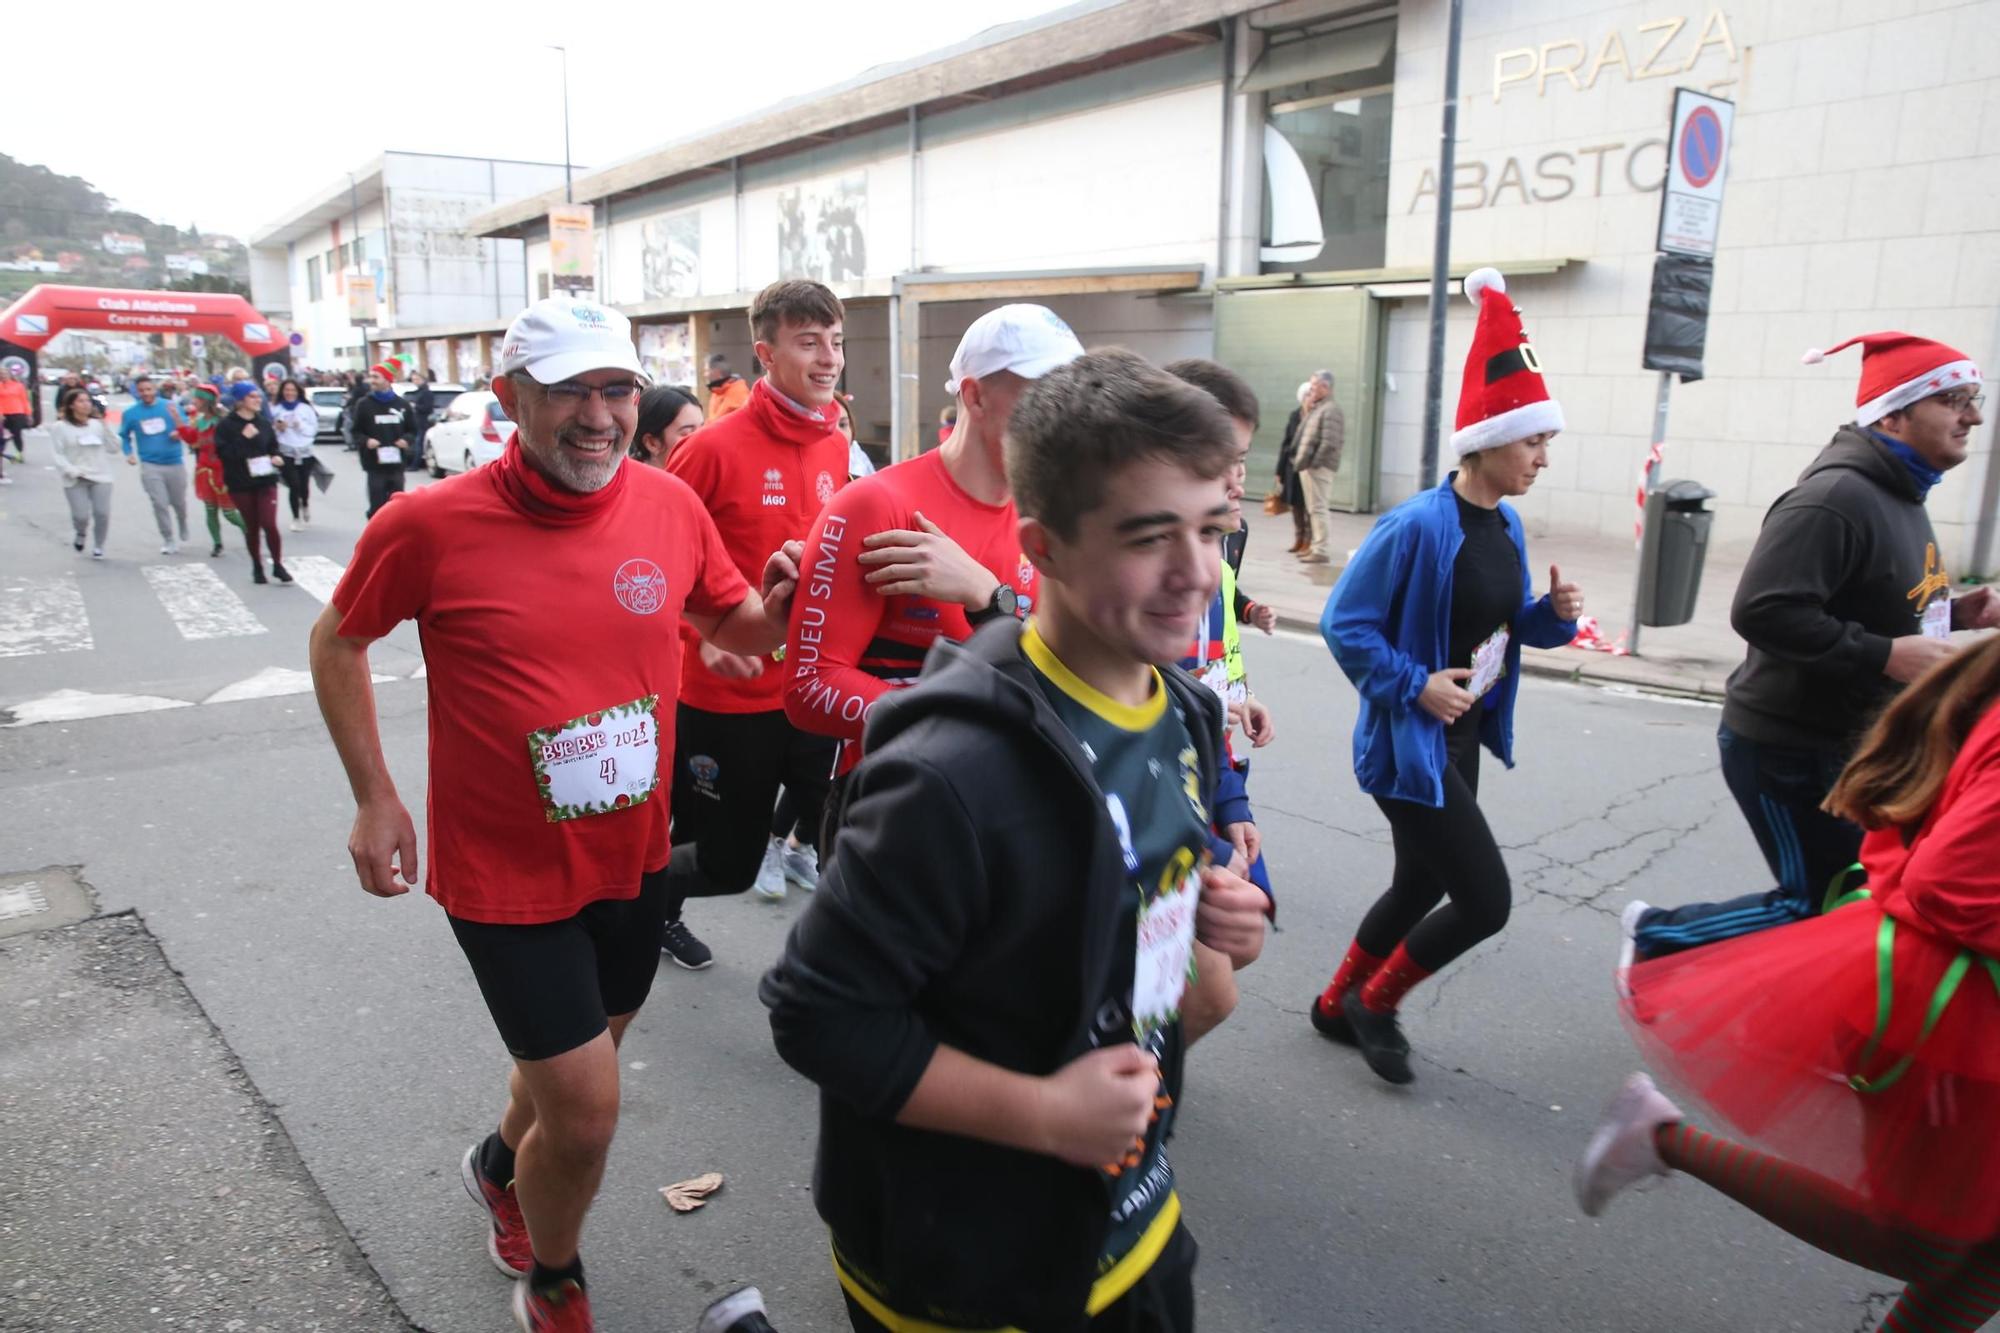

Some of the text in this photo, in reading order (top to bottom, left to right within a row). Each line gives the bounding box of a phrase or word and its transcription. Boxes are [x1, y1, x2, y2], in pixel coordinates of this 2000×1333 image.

[1493, 8, 1738, 104] PRAZA
[1408, 138, 1668, 215] ABASTO
[97, 298, 196, 313] Club Atletismo
[762, 495, 786, 505] IAGO
[796, 515, 848, 678] BUEU SIMEI
[613, 727, 647, 747] 2023
[600, 757, 616, 785] 4
